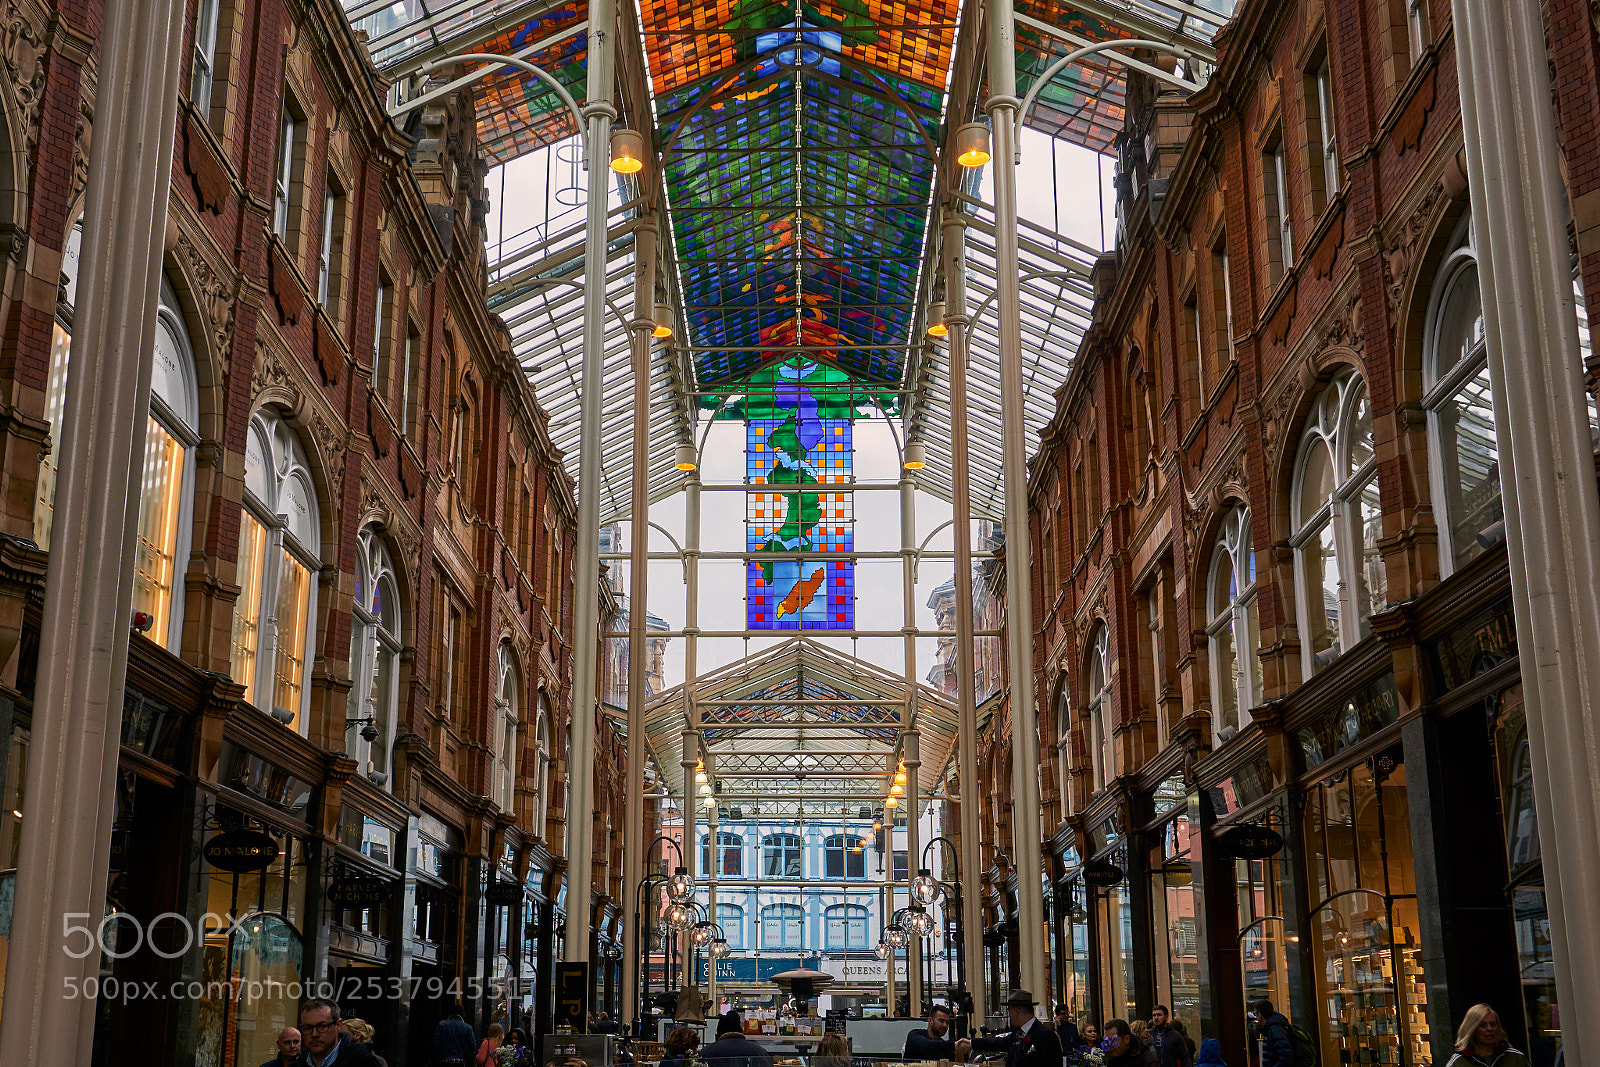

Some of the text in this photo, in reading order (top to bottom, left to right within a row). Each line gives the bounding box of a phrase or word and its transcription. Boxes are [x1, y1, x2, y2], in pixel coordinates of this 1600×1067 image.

[208, 846, 274, 856] JO MALONE
[337, 883, 377, 892] HARVEY
[334, 892, 379, 901] NCHOLS
[703, 962, 733, 971] OLIE
